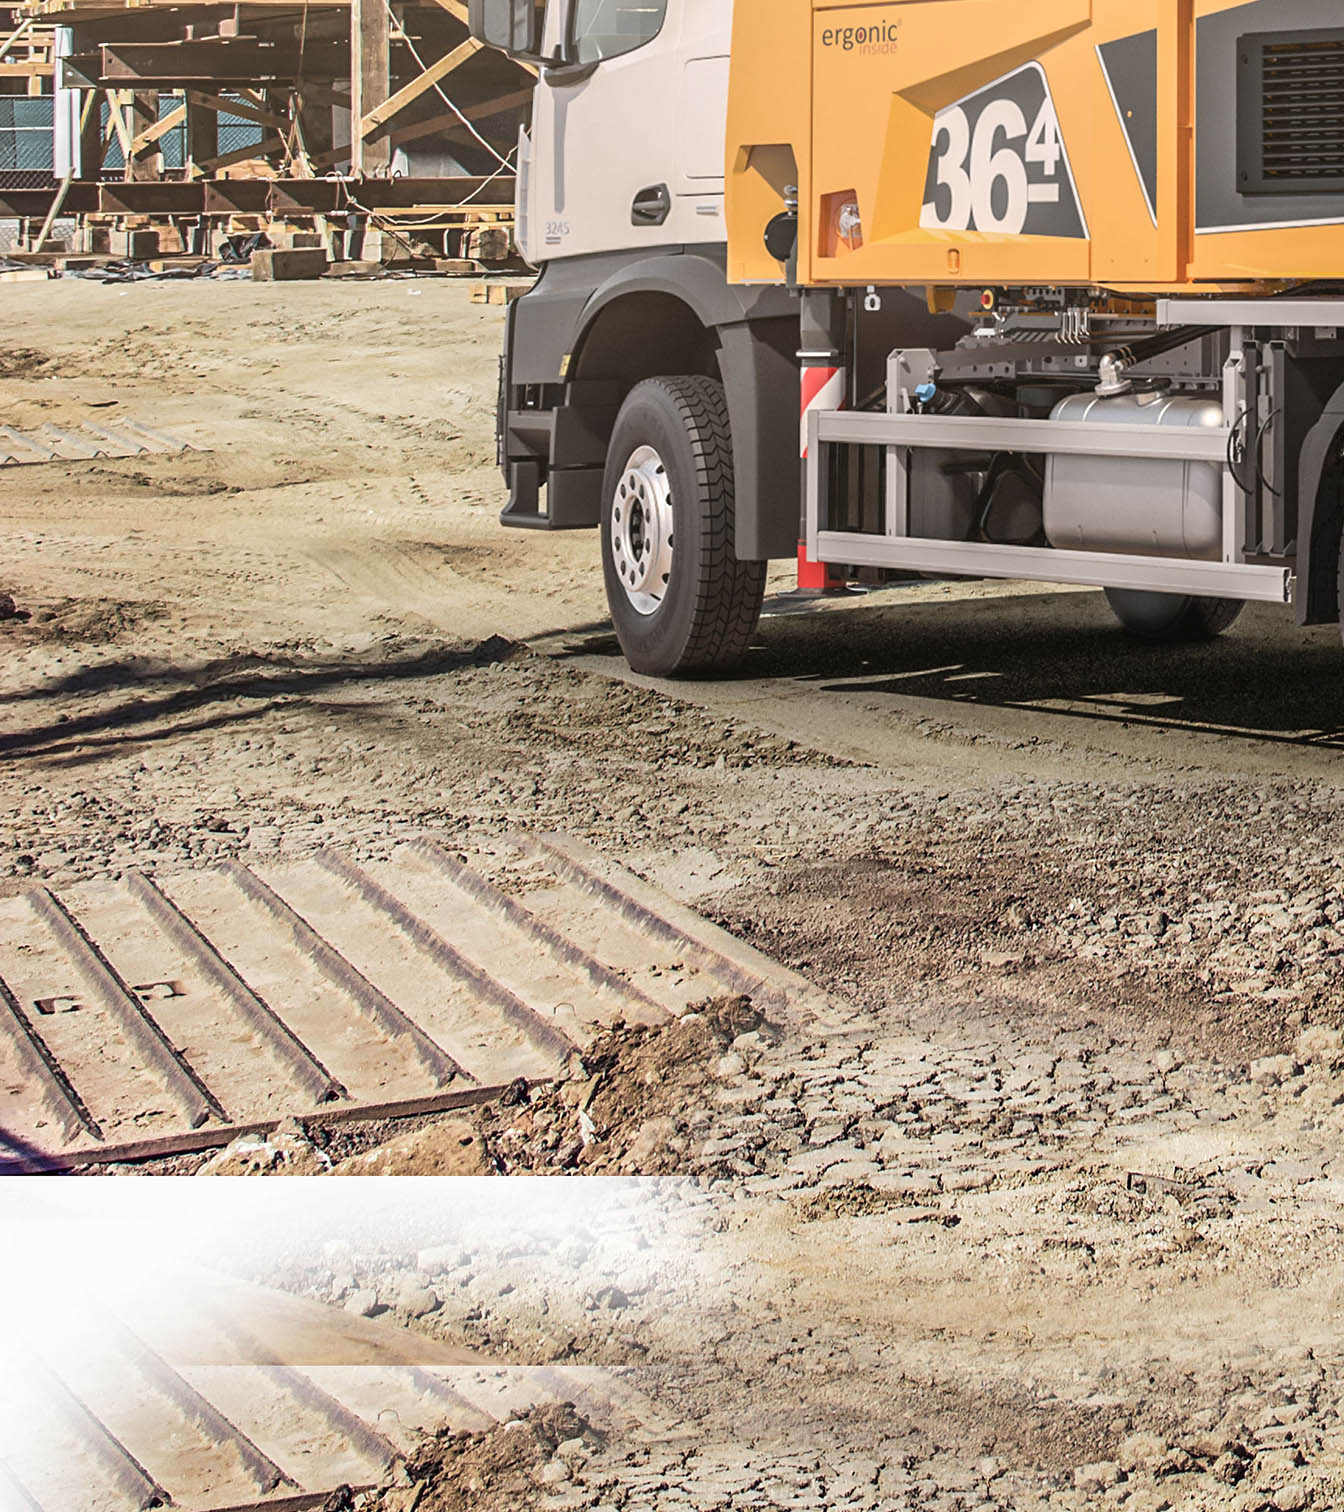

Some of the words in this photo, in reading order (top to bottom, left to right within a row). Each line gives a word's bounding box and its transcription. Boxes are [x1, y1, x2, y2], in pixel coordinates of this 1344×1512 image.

[821, 18, 898, 51] ergonic
[858, 42, 898, 56] inside
[545, 222, 570, 236] 3245
